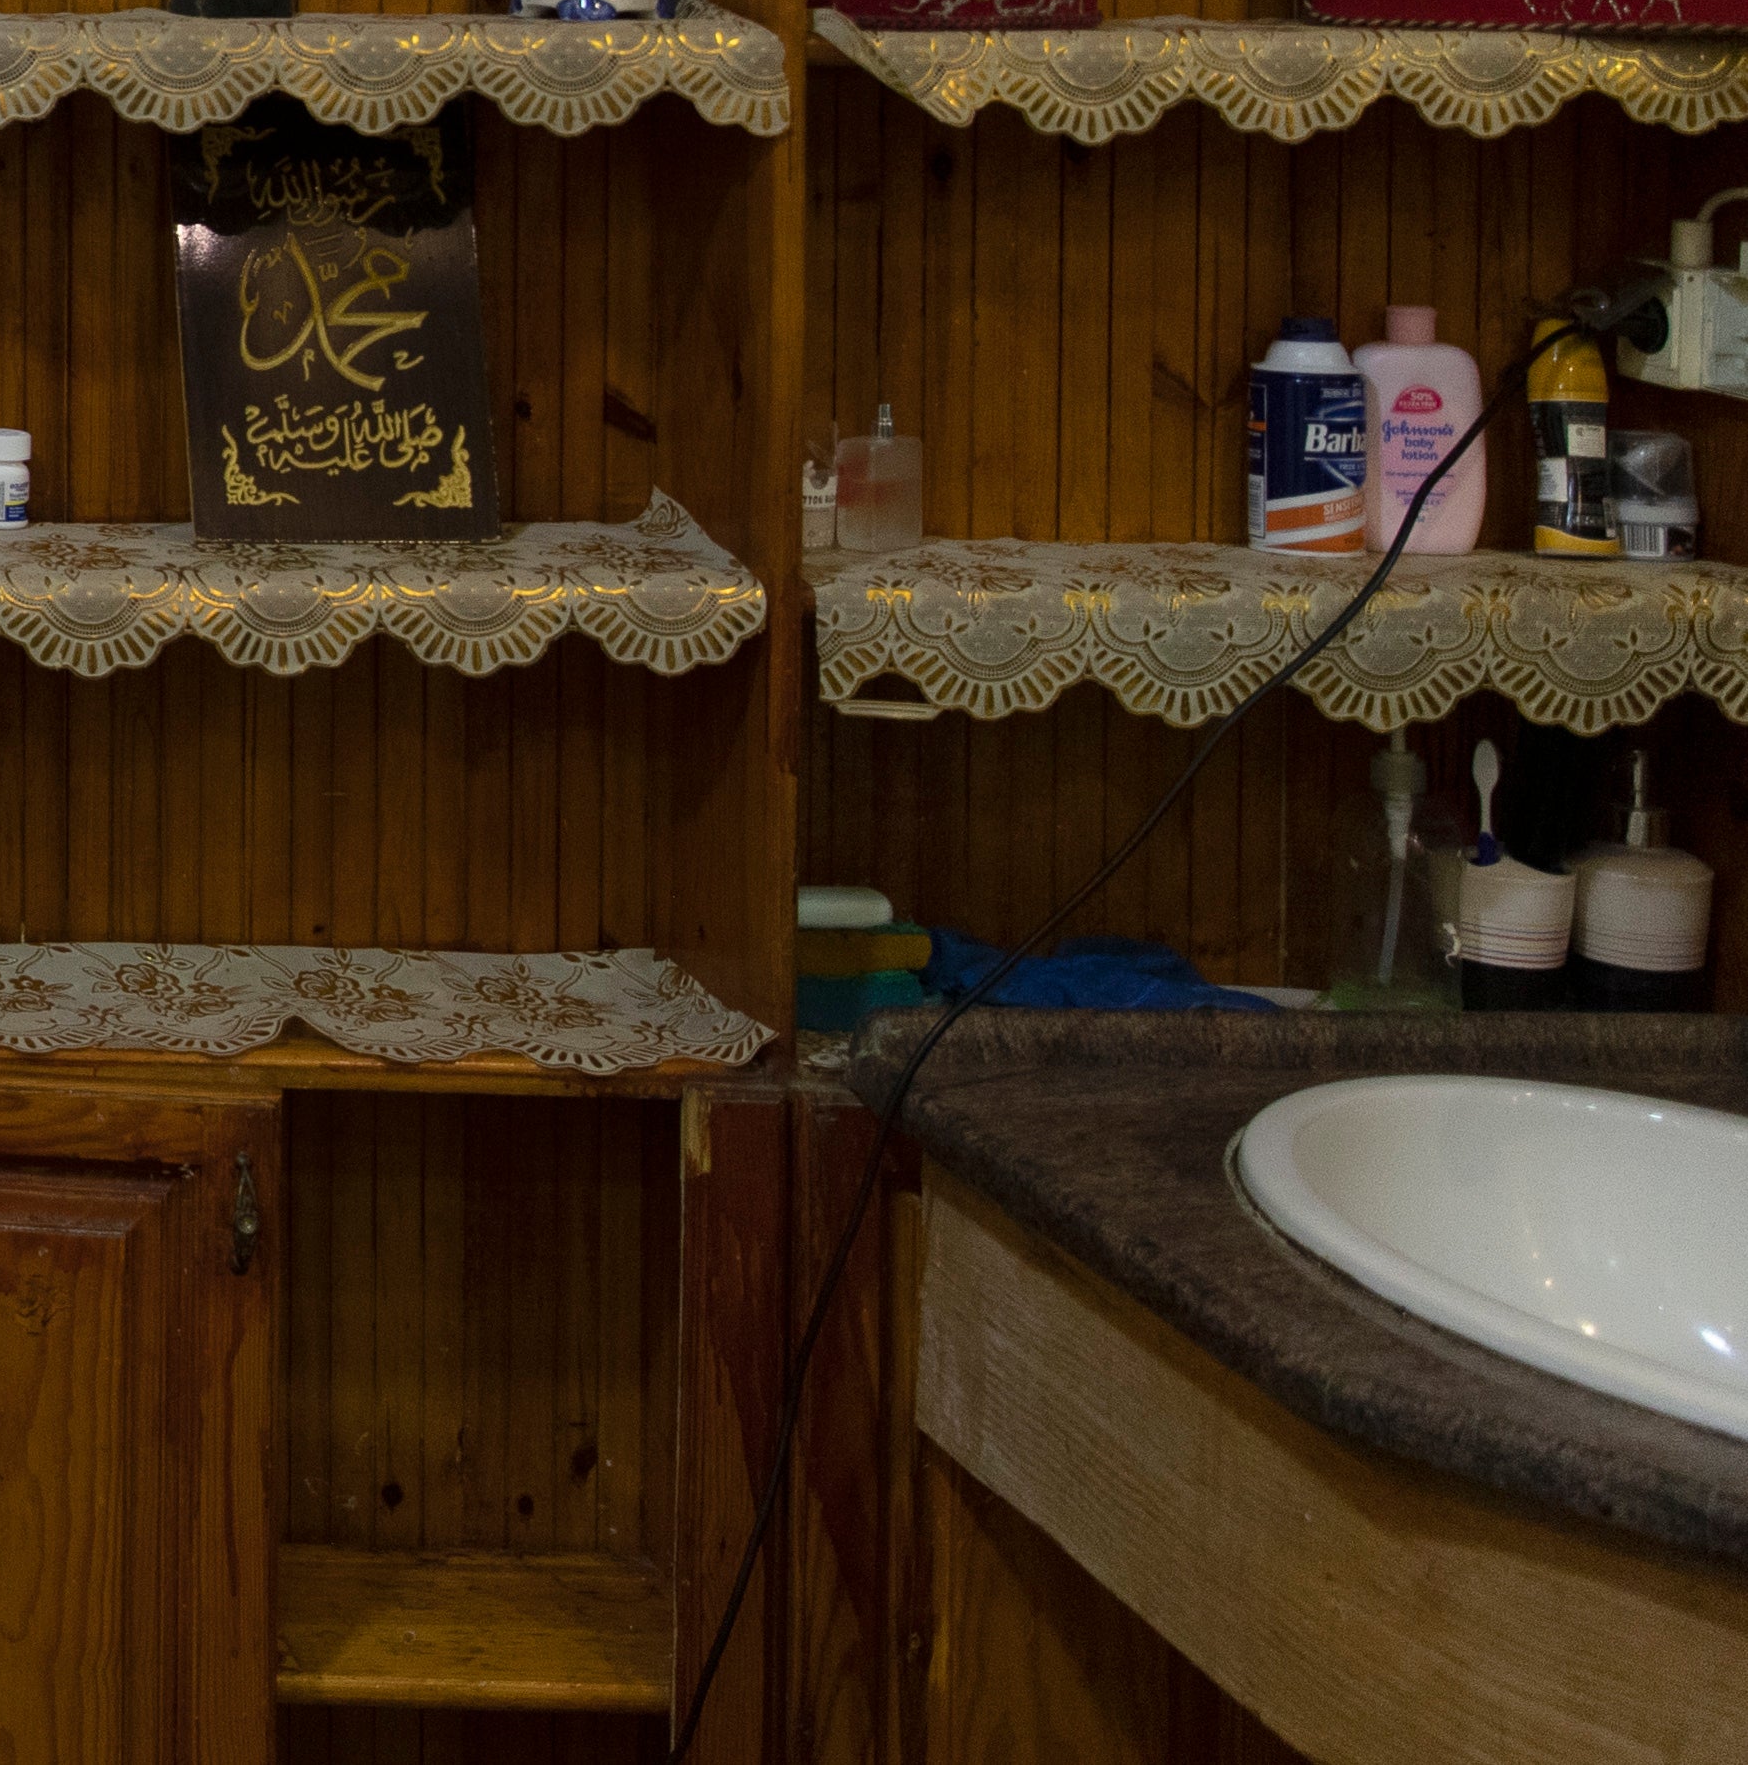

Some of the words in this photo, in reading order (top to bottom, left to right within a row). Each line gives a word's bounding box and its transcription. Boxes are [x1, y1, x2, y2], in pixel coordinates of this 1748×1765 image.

[239, 231, 430, 392] محمد
[1404, 436, 1435, 450] baby
[1400, 449, 1439, 461] lotion
